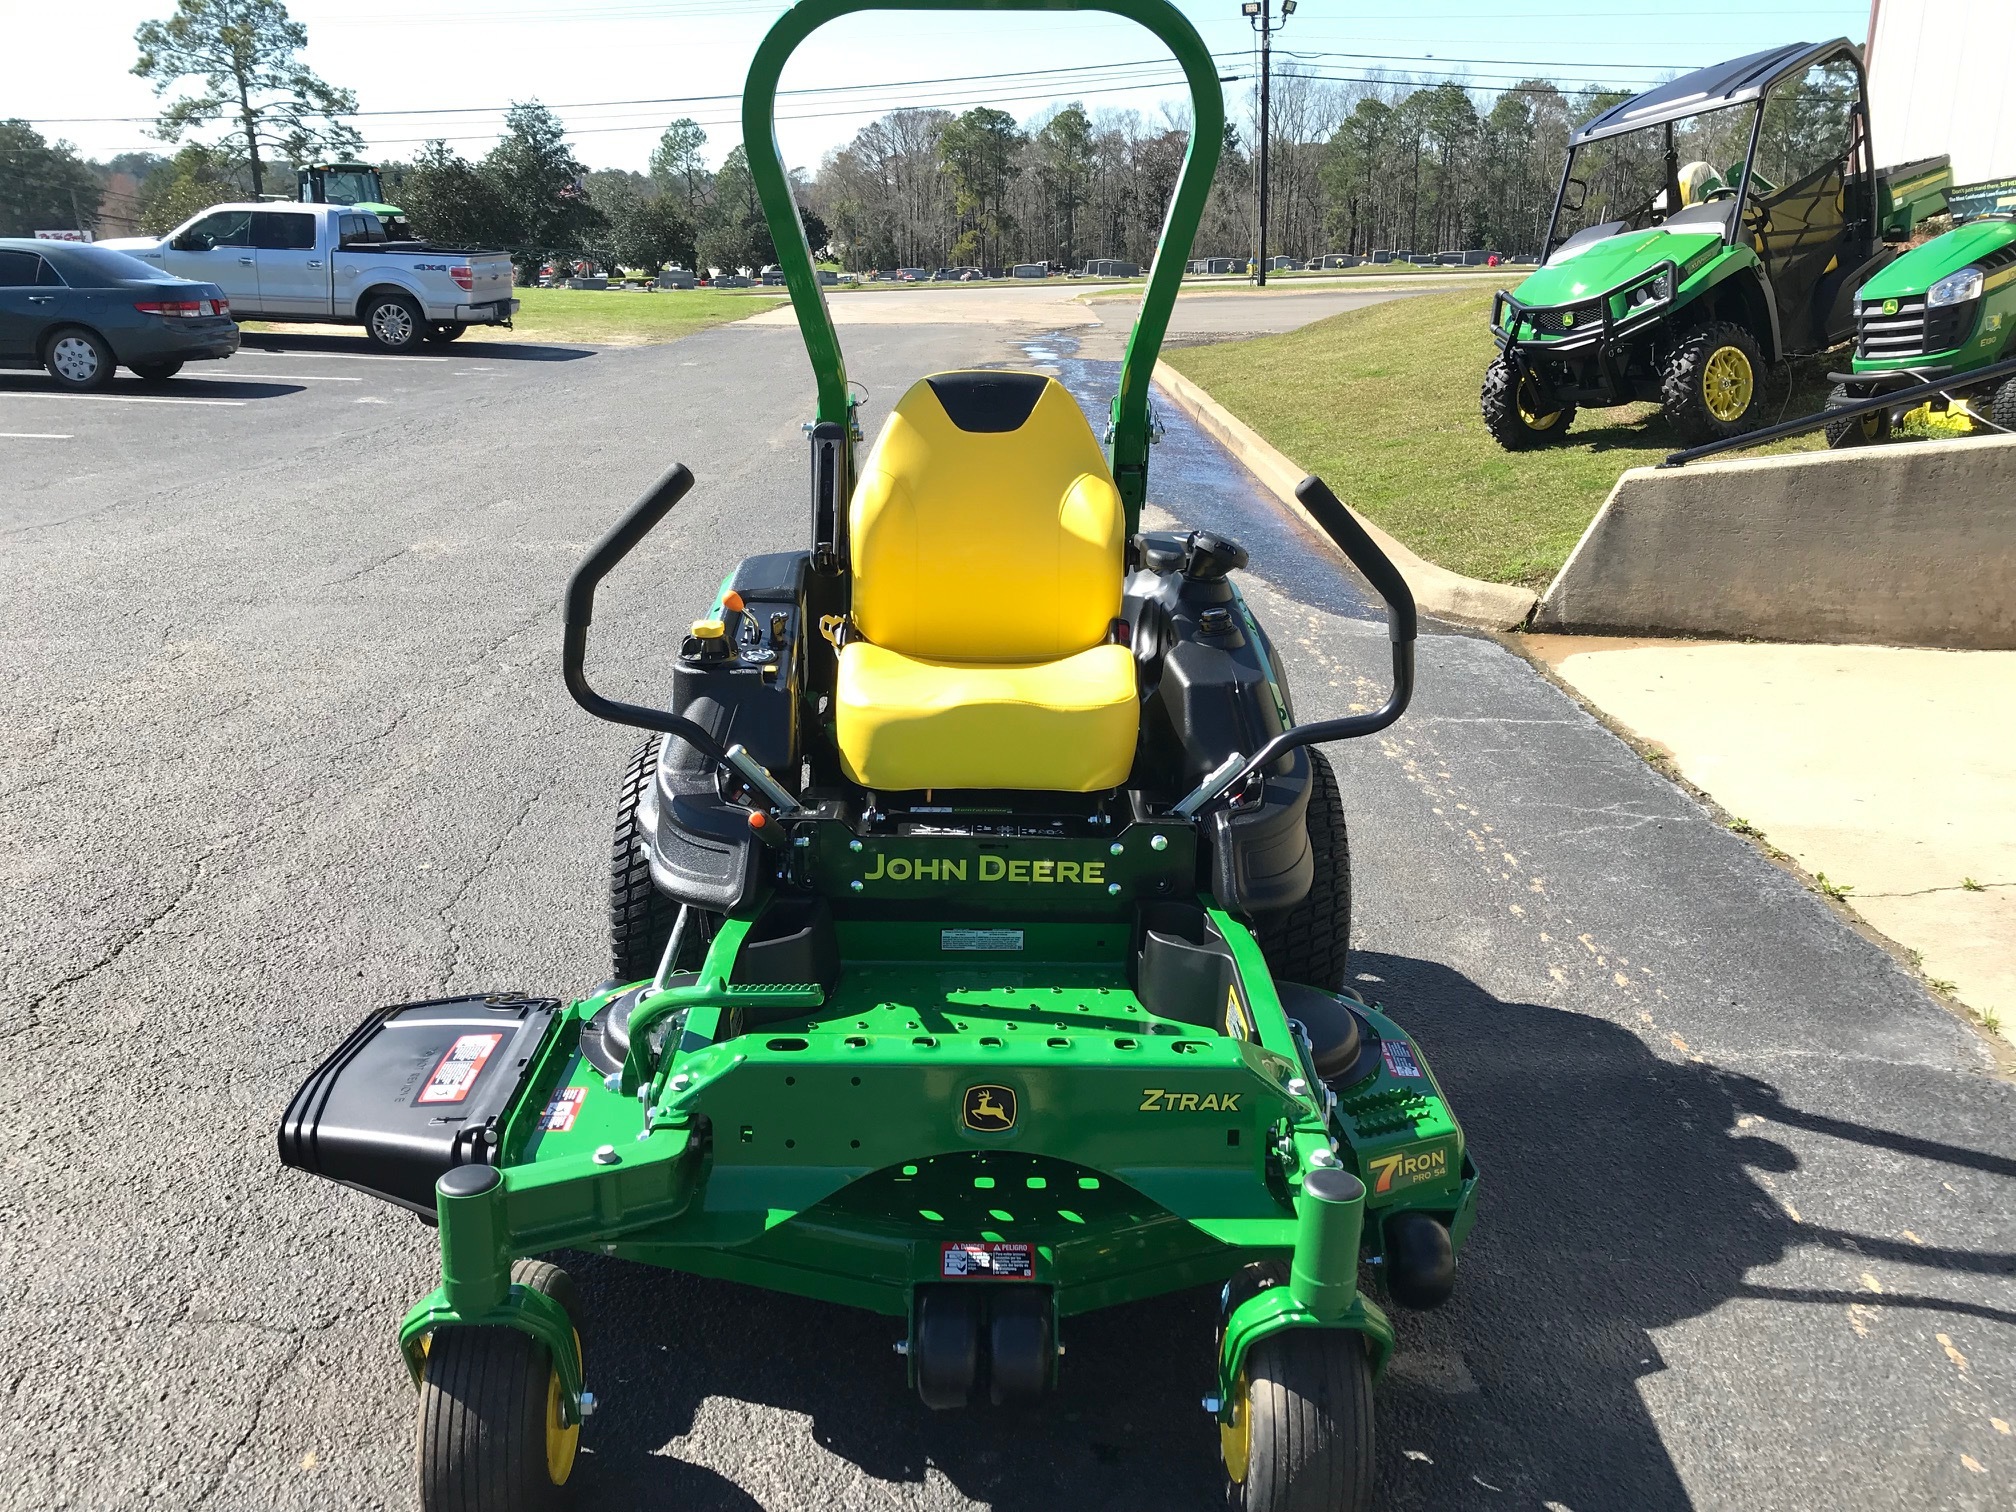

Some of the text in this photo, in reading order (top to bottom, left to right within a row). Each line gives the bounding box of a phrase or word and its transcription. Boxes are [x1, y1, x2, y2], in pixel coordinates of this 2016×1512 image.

[864, 853, 1106, 884] JOHN DEERE
[1139, 1088, 1242, 1112] ZTRAK
[1412, 1167, 1446, 1183] PRO 54
